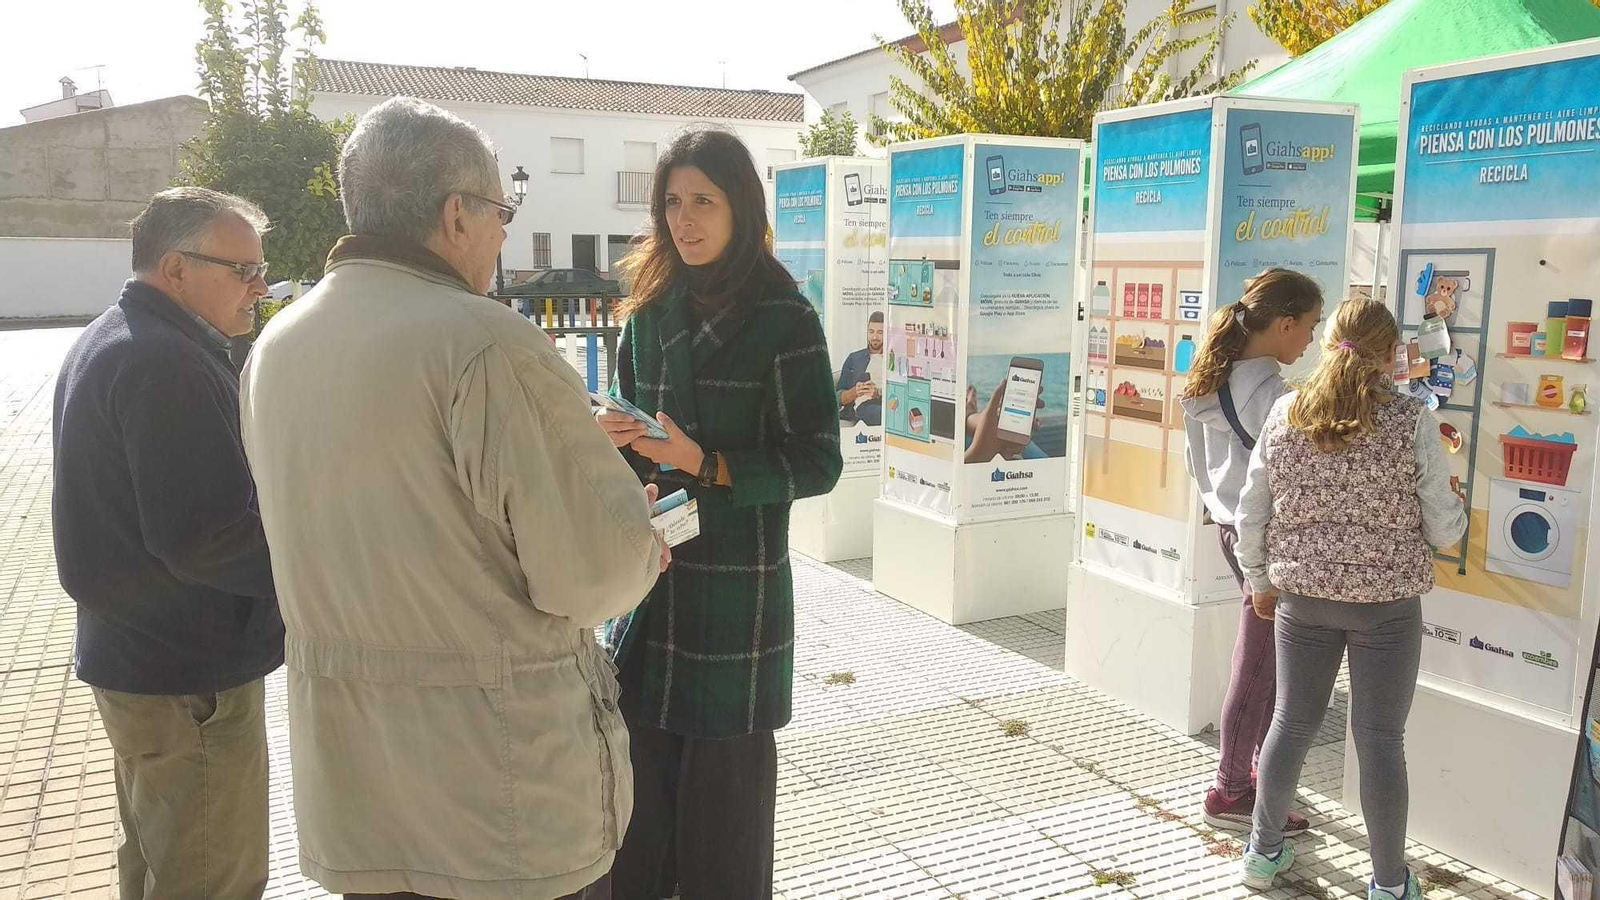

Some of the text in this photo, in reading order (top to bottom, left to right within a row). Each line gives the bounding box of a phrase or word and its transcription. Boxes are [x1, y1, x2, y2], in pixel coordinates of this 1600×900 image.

[1421, 106, 1600, 132] RECICLANDO AYUDAS A MANTENER EL AIRE LIMP
[1420, 118, 1600, 154] PIENSA CON LOS PULMONES
[1103, 158, 1201, 181] PIENSA CON LOS PULMONES
[1479, 164, 1528, 184] RECICLA
[896, 180, 958, 197] PIENSA CON LOS PULMONES
[1136, 190, 1162, 204] RECICLA
[1236, 195, 1296, 210] Ten siempre
[916, 204, 934, 215] RECICLA
[984, 210, 1034, 223] Ten siempre
[844, 218, 887, 230] Ten siempre
[1235, 206, 1331, 242] el control
[983, 219, 1062, 246] el control
[1006, 470, 1034, 480] Giahsa
[1434, 630, 1444, 638] 10
[1484, 643, 1514, 658] Giahsa
